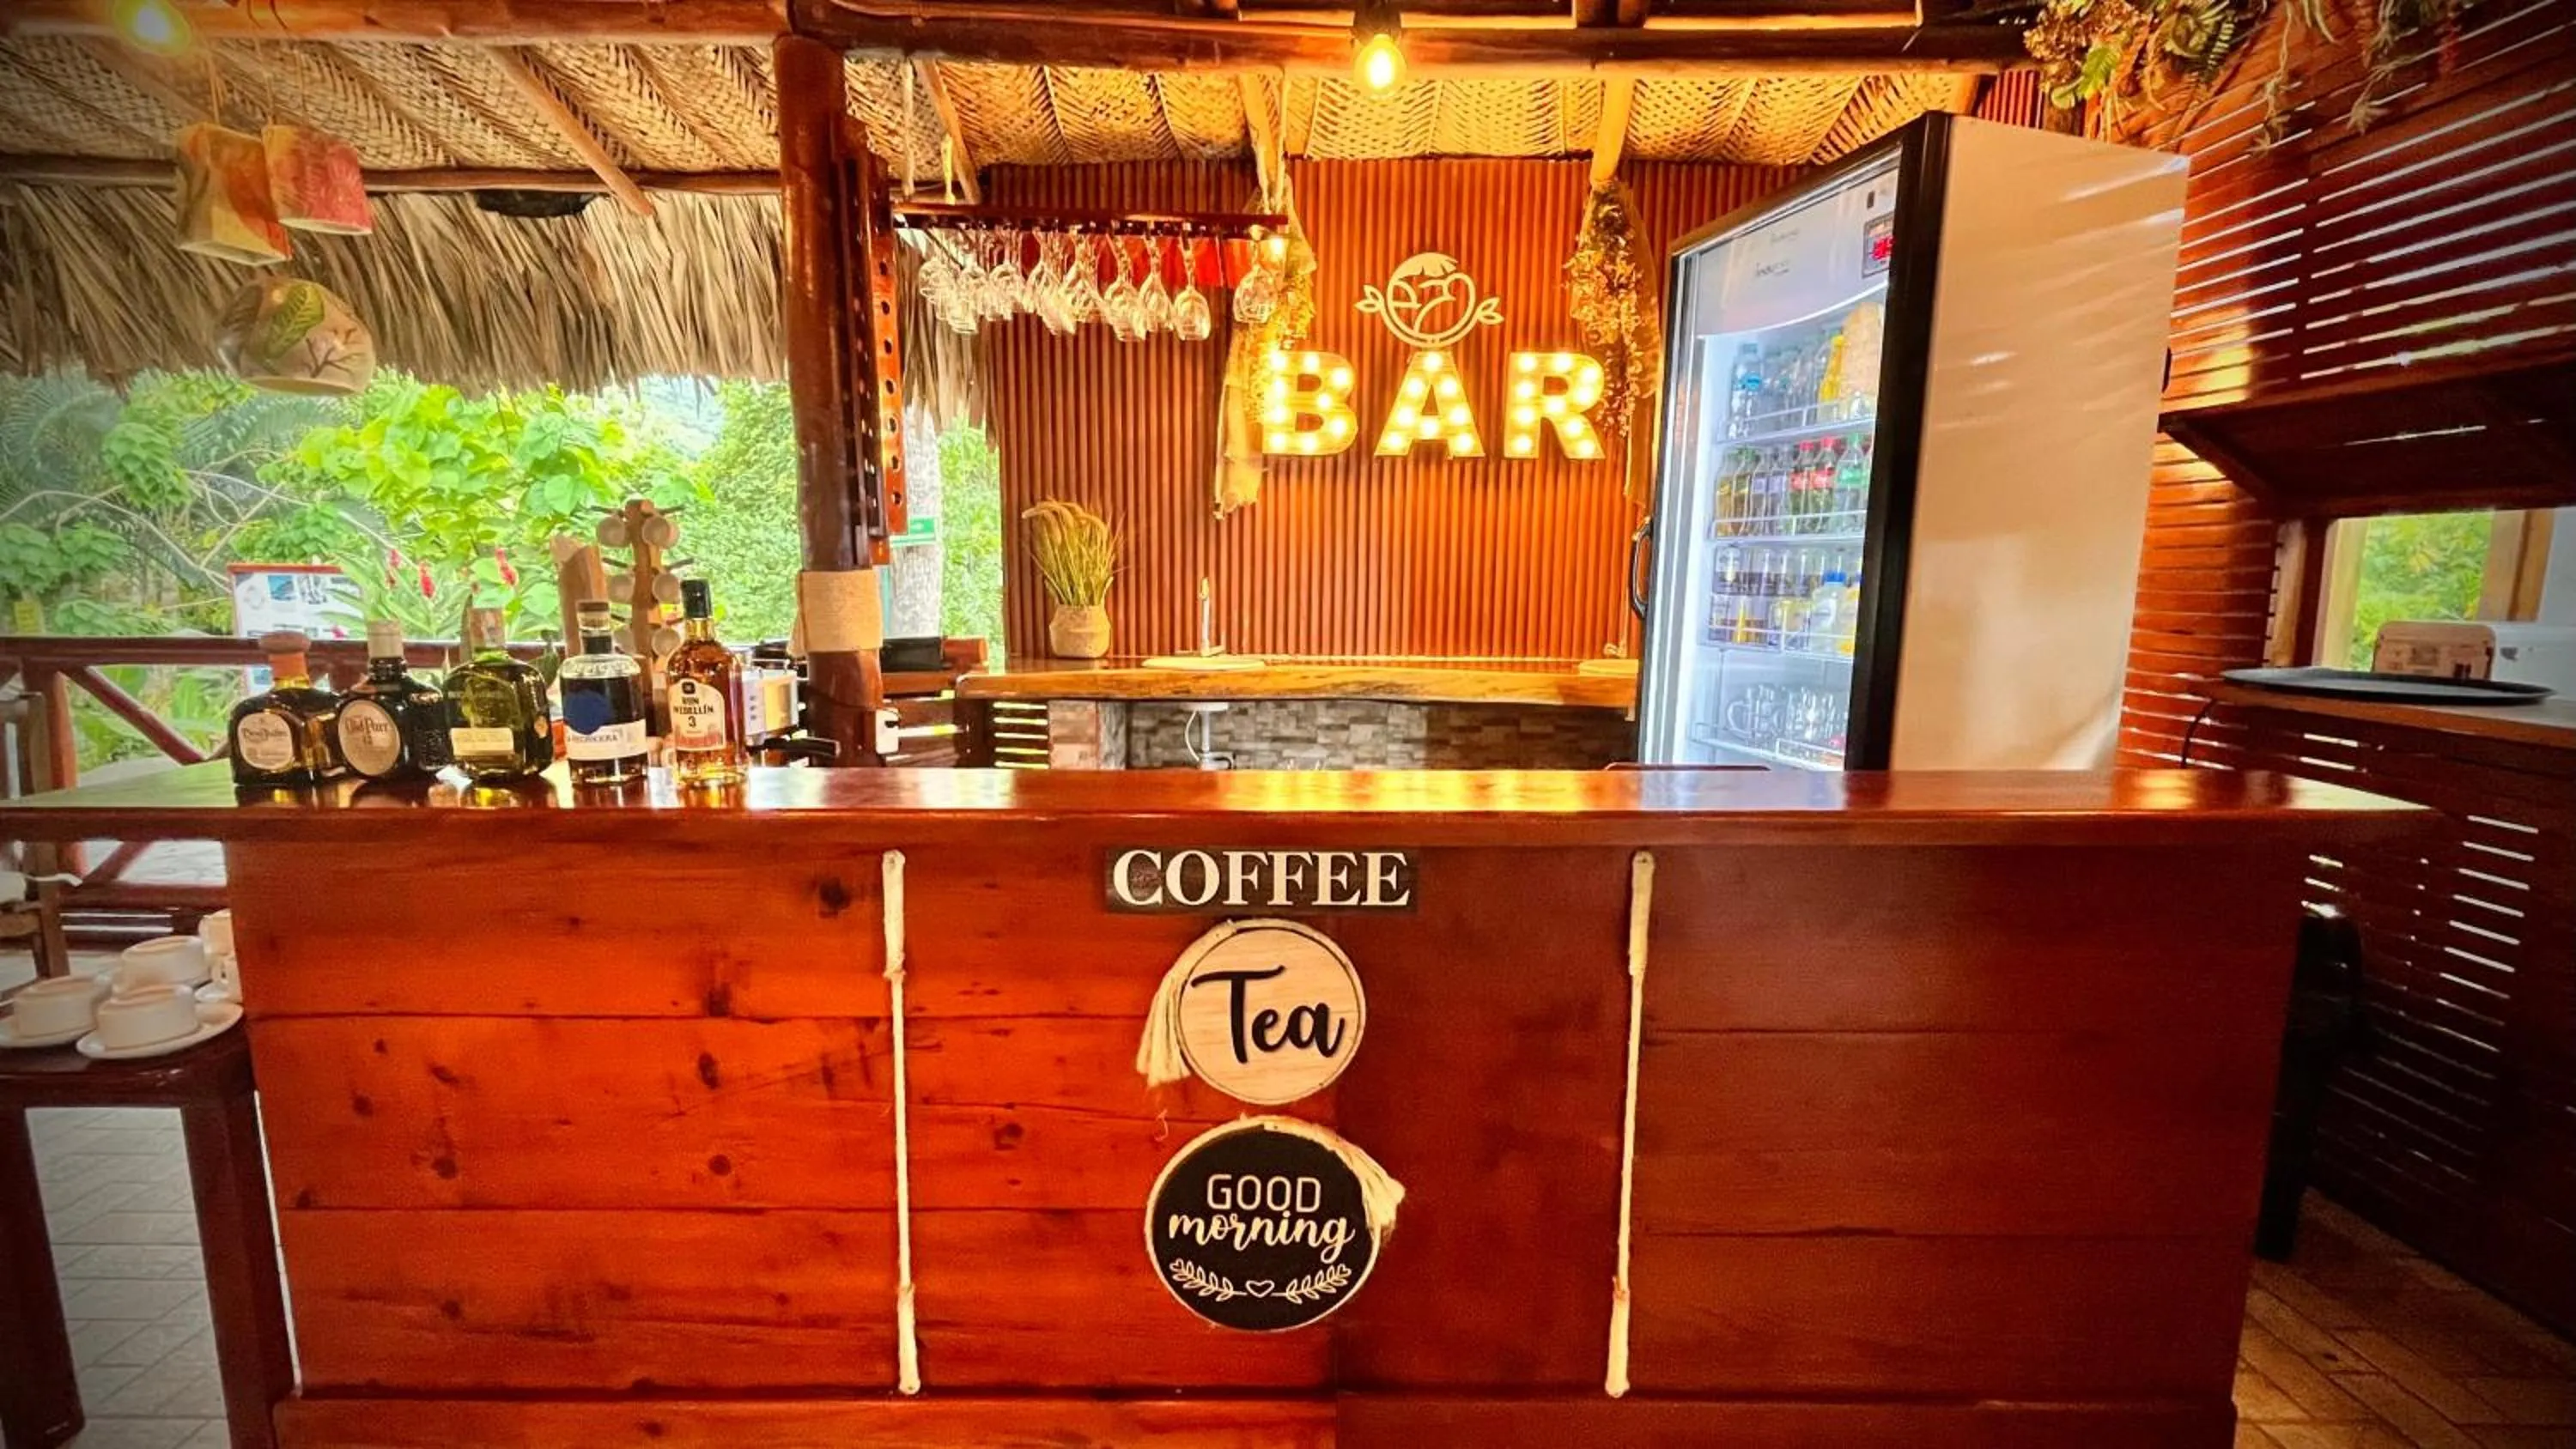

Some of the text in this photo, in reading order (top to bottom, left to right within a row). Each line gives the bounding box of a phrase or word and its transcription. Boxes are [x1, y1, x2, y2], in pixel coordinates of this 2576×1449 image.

[1262, 349, 1606, 460] BAR
[682, 696, 700, 705] RON
[688, 715, 697, 728] 3
[1113, 848, 1411, 906] COFFEE
[1190, 965, 1346, 1064] Tea
[1206, 1173, 1321, 1211] GOOD
[1168, 1210, 1356, 1264] morning
